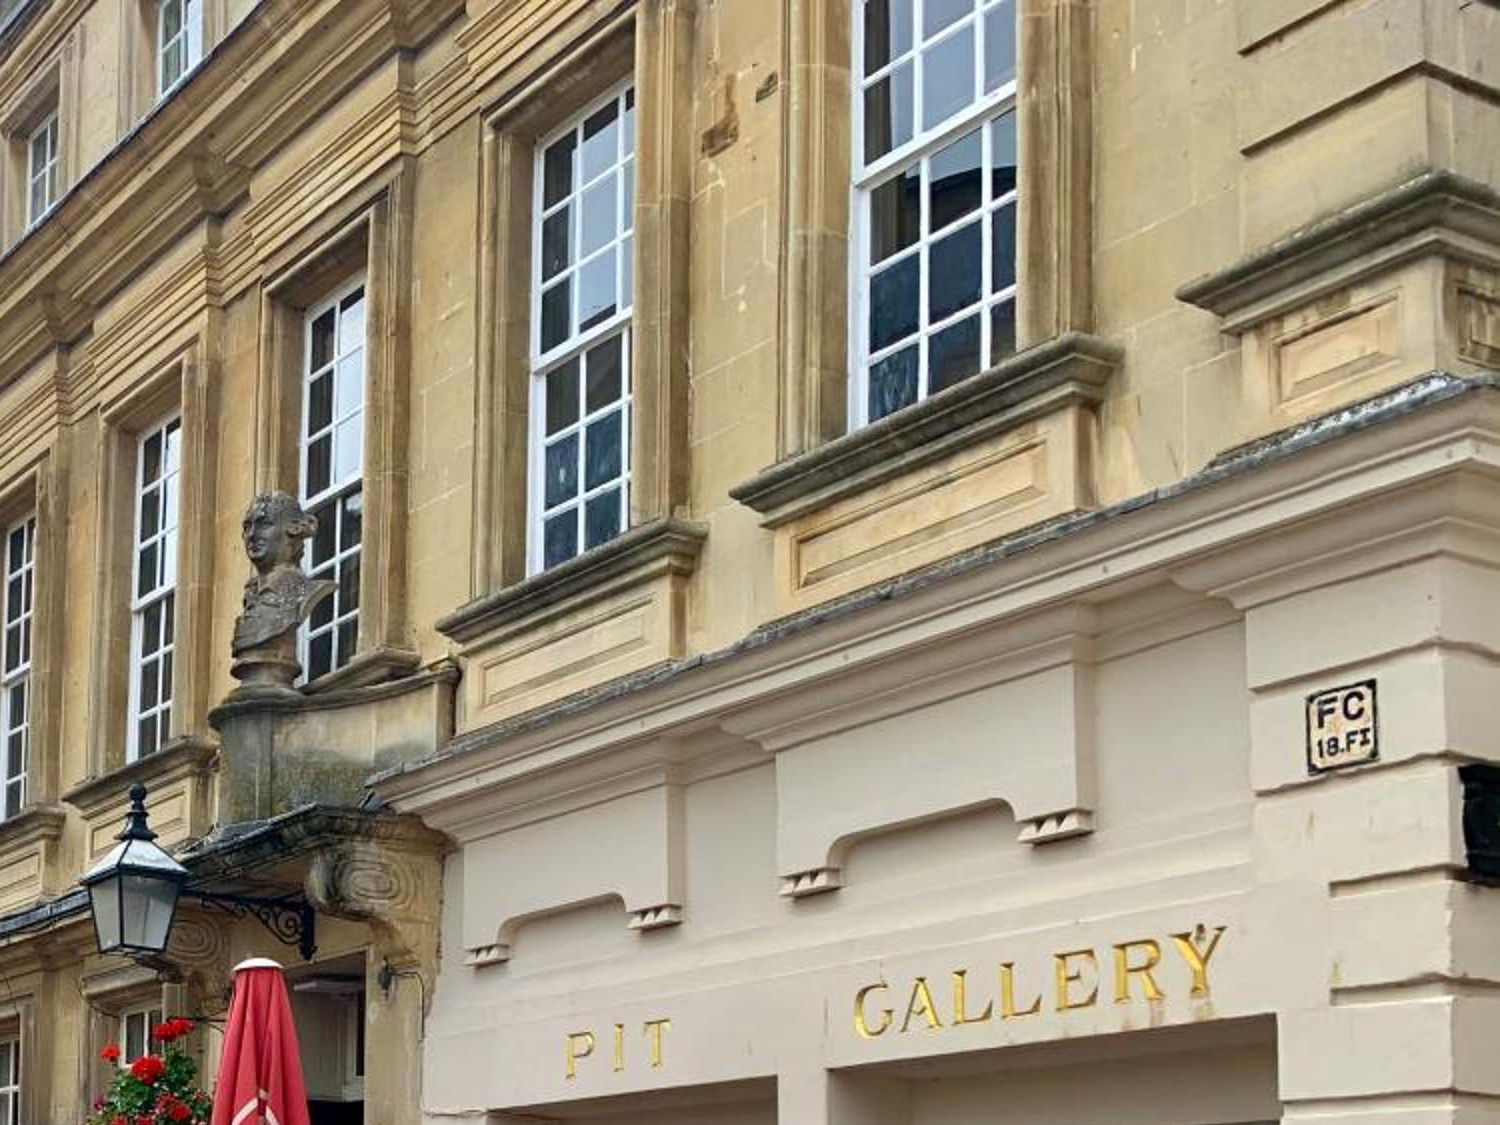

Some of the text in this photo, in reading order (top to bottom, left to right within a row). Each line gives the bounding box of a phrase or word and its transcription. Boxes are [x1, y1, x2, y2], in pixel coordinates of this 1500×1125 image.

[1316, 690, 1365, 729] FC
[564, 924, 1228, 1080] PIT GALLERY
